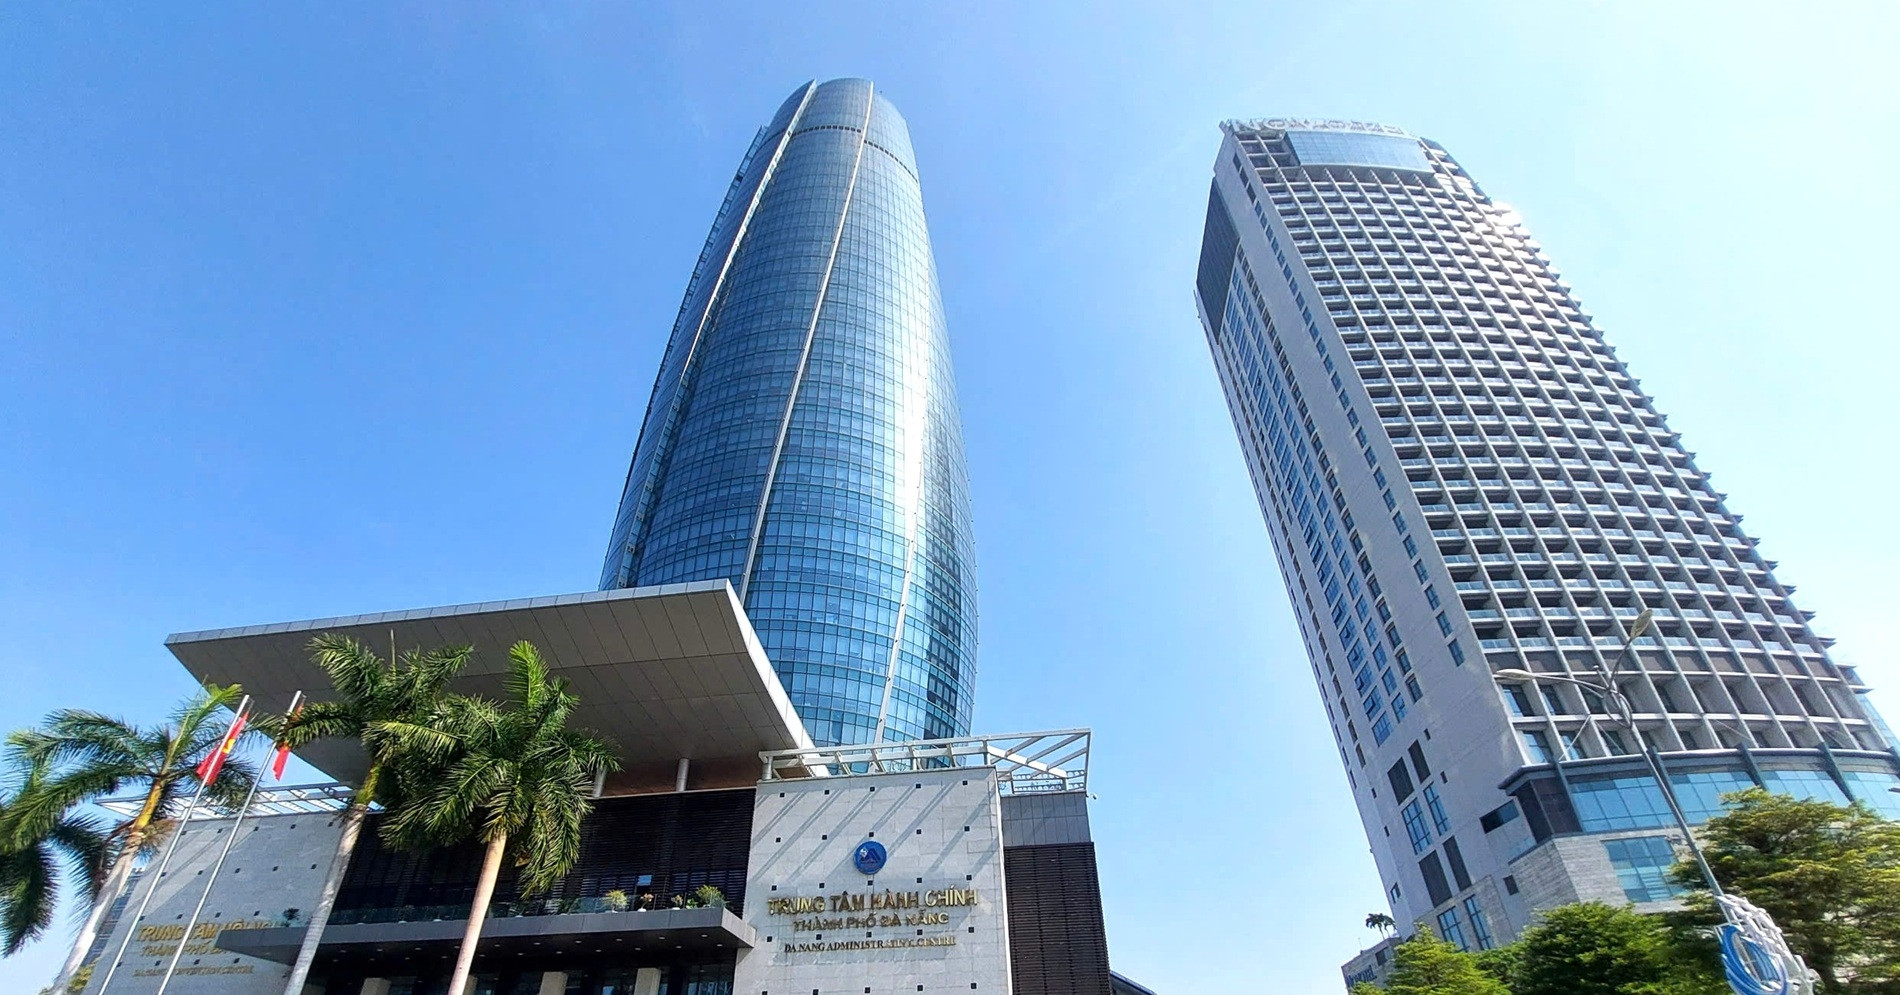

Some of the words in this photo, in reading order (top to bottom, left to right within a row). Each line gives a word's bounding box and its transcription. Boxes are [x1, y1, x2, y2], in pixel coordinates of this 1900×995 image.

[768, 896, 826, 915] TRUNG
[830, 890, 866, 912] TÂM
[870, 888, 919, 909] HÀNH
[924, 885, 978, 907] CHÍNH
[793, 916, 843, 931] THÀNH
[846, 911, 878, 929] PHỐ
[798, 942, 825, 952] NANG
